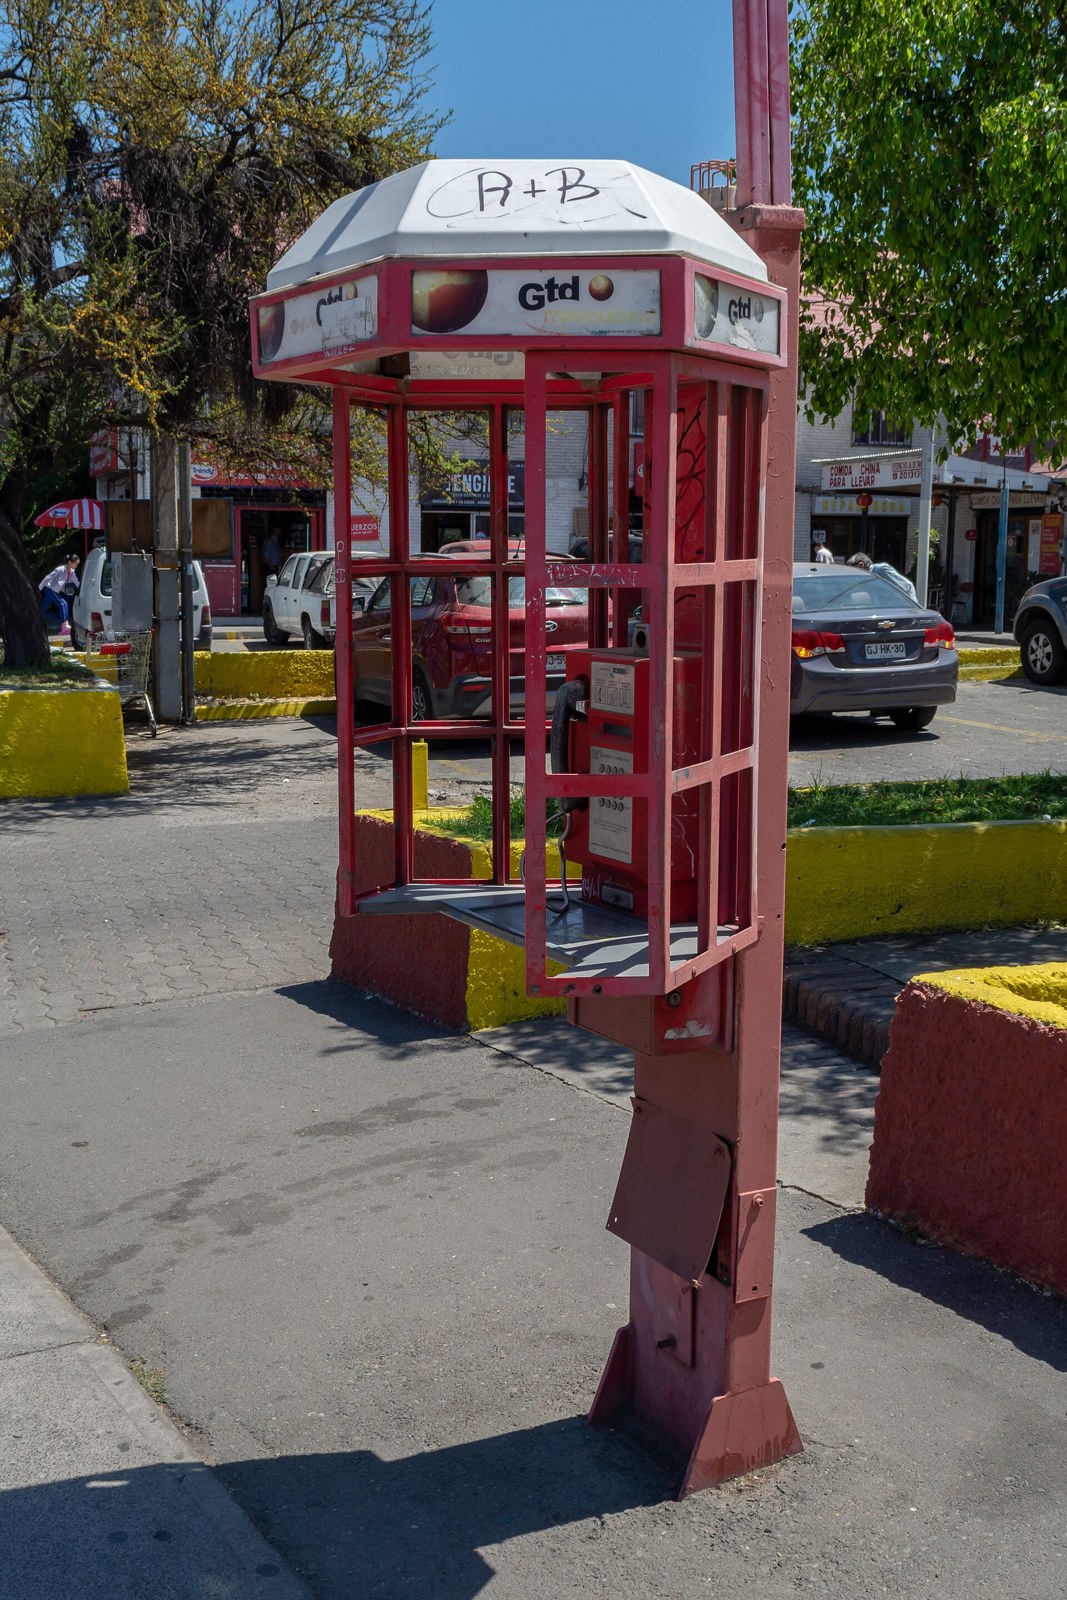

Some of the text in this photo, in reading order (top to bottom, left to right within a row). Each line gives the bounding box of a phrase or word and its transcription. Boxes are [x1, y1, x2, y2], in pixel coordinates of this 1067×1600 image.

[517, 275, 580, 311] Gtd
[728, 296, 751, 326] Gtd
[830, 463, 880, 476] COMIDA CHINA
[446, 473, 515, 493] JENGIE
[829, 475, 875, 488] PARA LLEVAR
[351, 523, 378, 531] UERZOS
[866, 645, 878, 655] GJ
